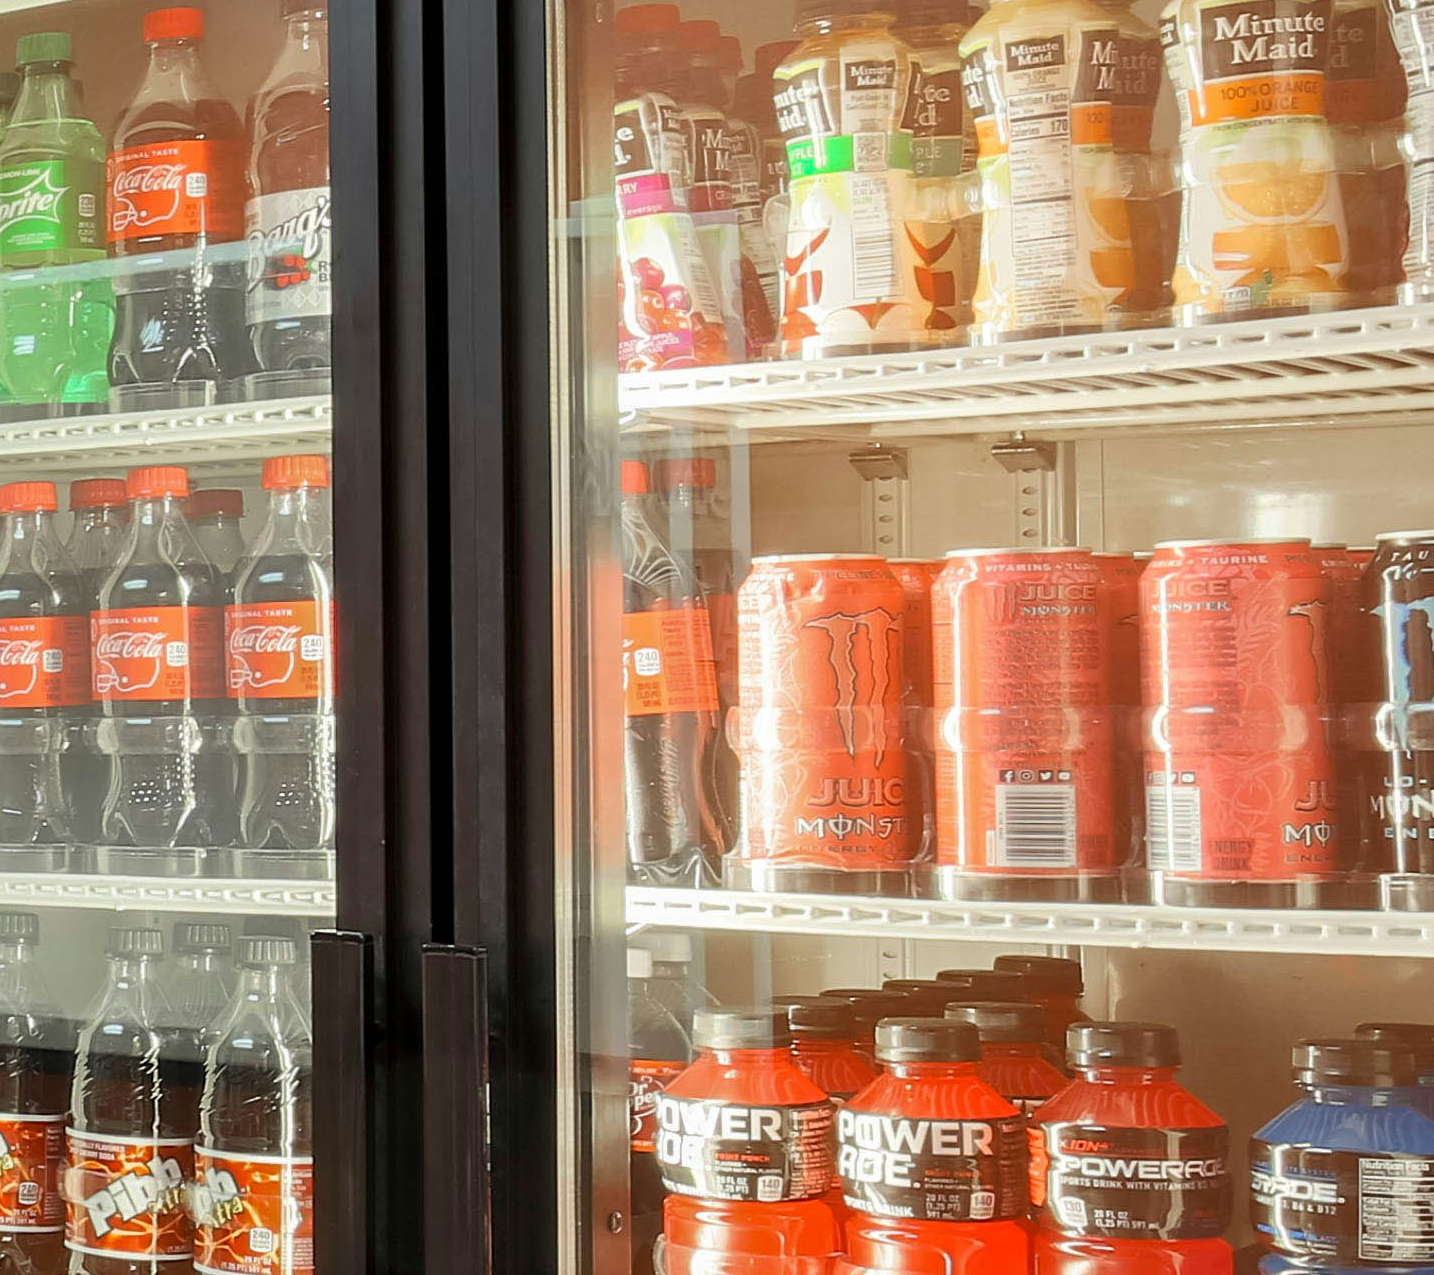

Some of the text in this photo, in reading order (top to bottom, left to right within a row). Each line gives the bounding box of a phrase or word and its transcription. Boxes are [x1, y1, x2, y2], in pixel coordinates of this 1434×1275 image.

[1212, 12, 1326, 44] Minute
[1009, 40, 1060, 58] Minute
[1230, 34, 1316, 66] Maid
[1017, 51, 1055, 68] Maid
[1218, 81, 1321, 102] 100% ORANGE
[1249, 96, 1300, 113] JUICE
[1050, 118, 1070, 133] 170
[112, 164, 187, 197] Coca-Cola
[985, 562, 1053, 574] VITAMINS
[1200, 553, 1269, 567] TAURINE
[1020, 581, 1096, 603] JUICE
[1151, 578, 1229, 601] JUICE
[97, 630, 169, 661] Coca-Cola
[230, 623, 300, 655] Coca-Cola
[302, 638, 323, 652] 240
[44, 649, 62, 663] 240
[168, 644, 187, 655] 240
[836, 1109, 994, 1156] POWER
[1056, 1157, 1227, 1181] POWERADE
[1361, 1159, 1430, 1173] Nutrition Facts
[759, 1177, 781, 1191] 140
[82, 1155, 184, 1239] Pibb
[972, 1194, 994, 1209] 140
[252, 1228, 272, 1241] 240
